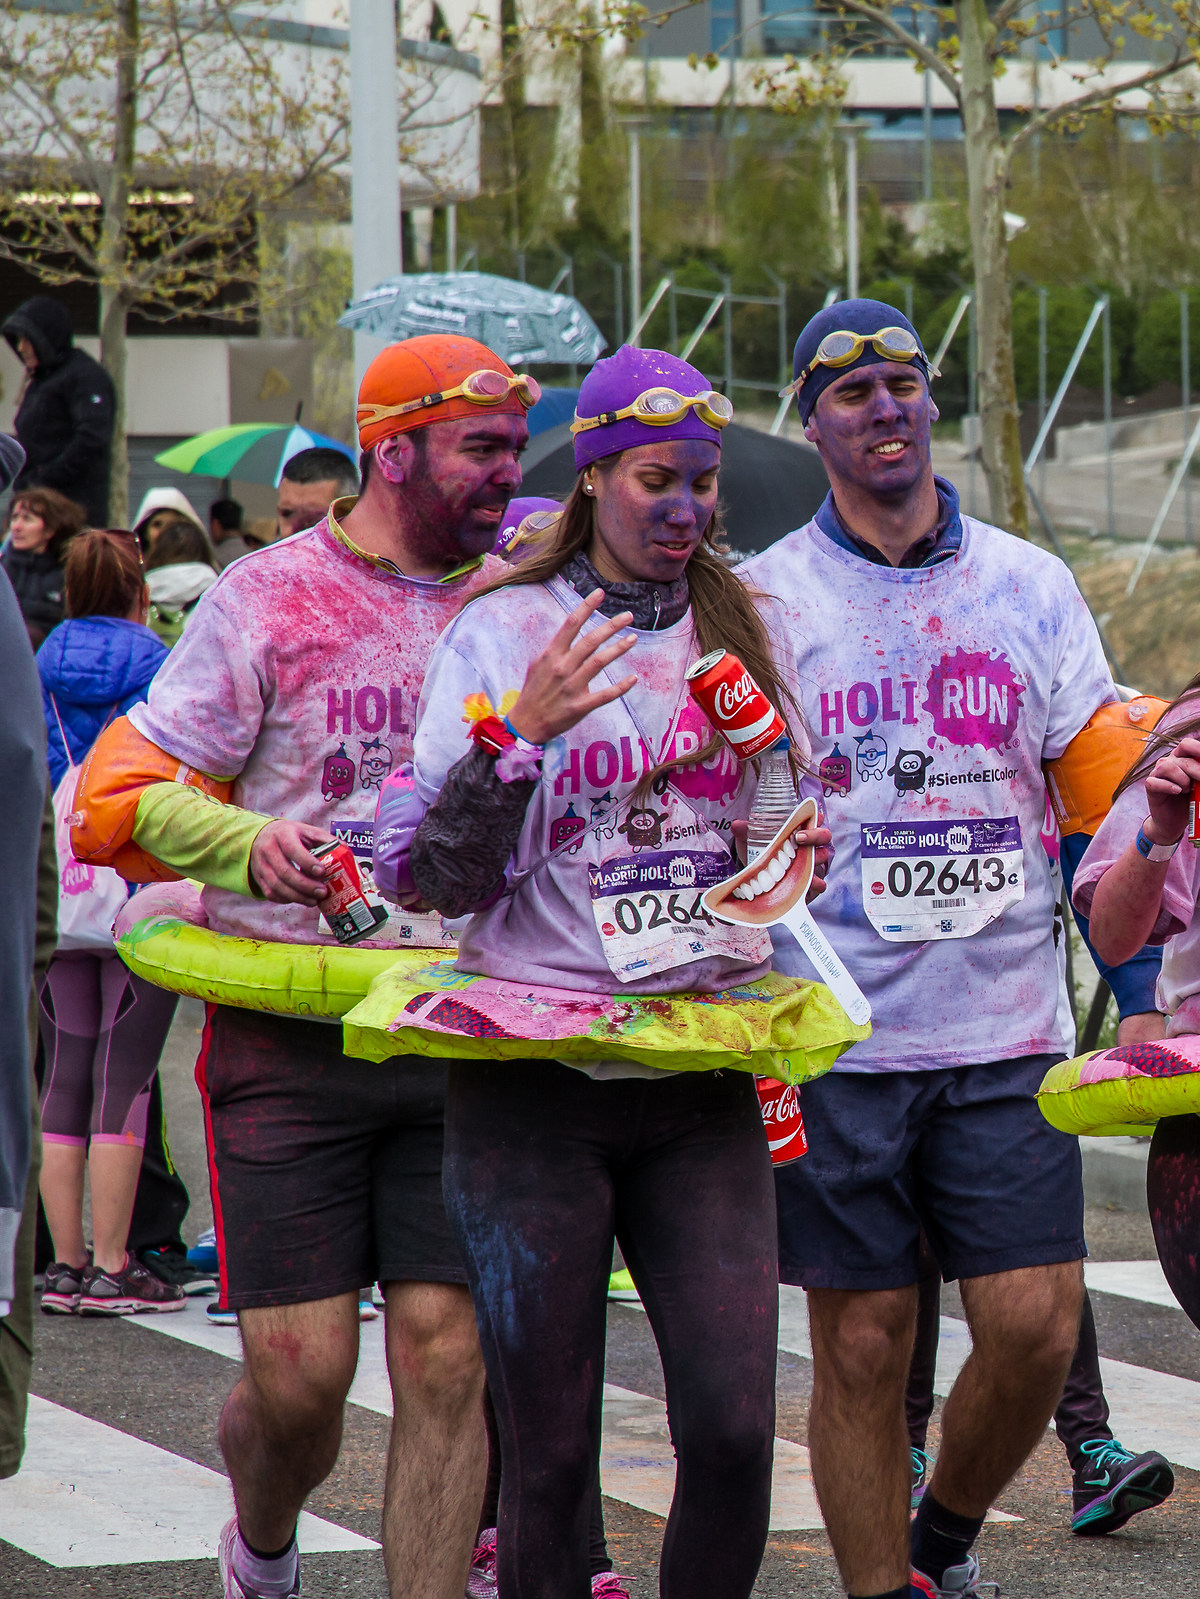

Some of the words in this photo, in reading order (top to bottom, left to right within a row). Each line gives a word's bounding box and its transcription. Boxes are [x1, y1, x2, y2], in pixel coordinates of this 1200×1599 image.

[326, 685, 418, 741] HOL
[820, 677, 918, 737] HOLI
[942, 675, 1008, 726] RUN
[554, 736, 653, 797] HOLI
[927, 767, 1019, 788] #SienteElColor
[335, 828, 374, 845] MADR
[866, 832, 917, 846] MADRID
[919, 833, 946, 848] HOLI
[950, 832, 968, 846] RUN
[589, 869, 638, 886] MADRID
[640, 865, 668, 882] HOLI
[672, 864, 693, 880] RUN
[887, 857, 1006, 898] 02643
[614, 893, 736, 936] 0264
